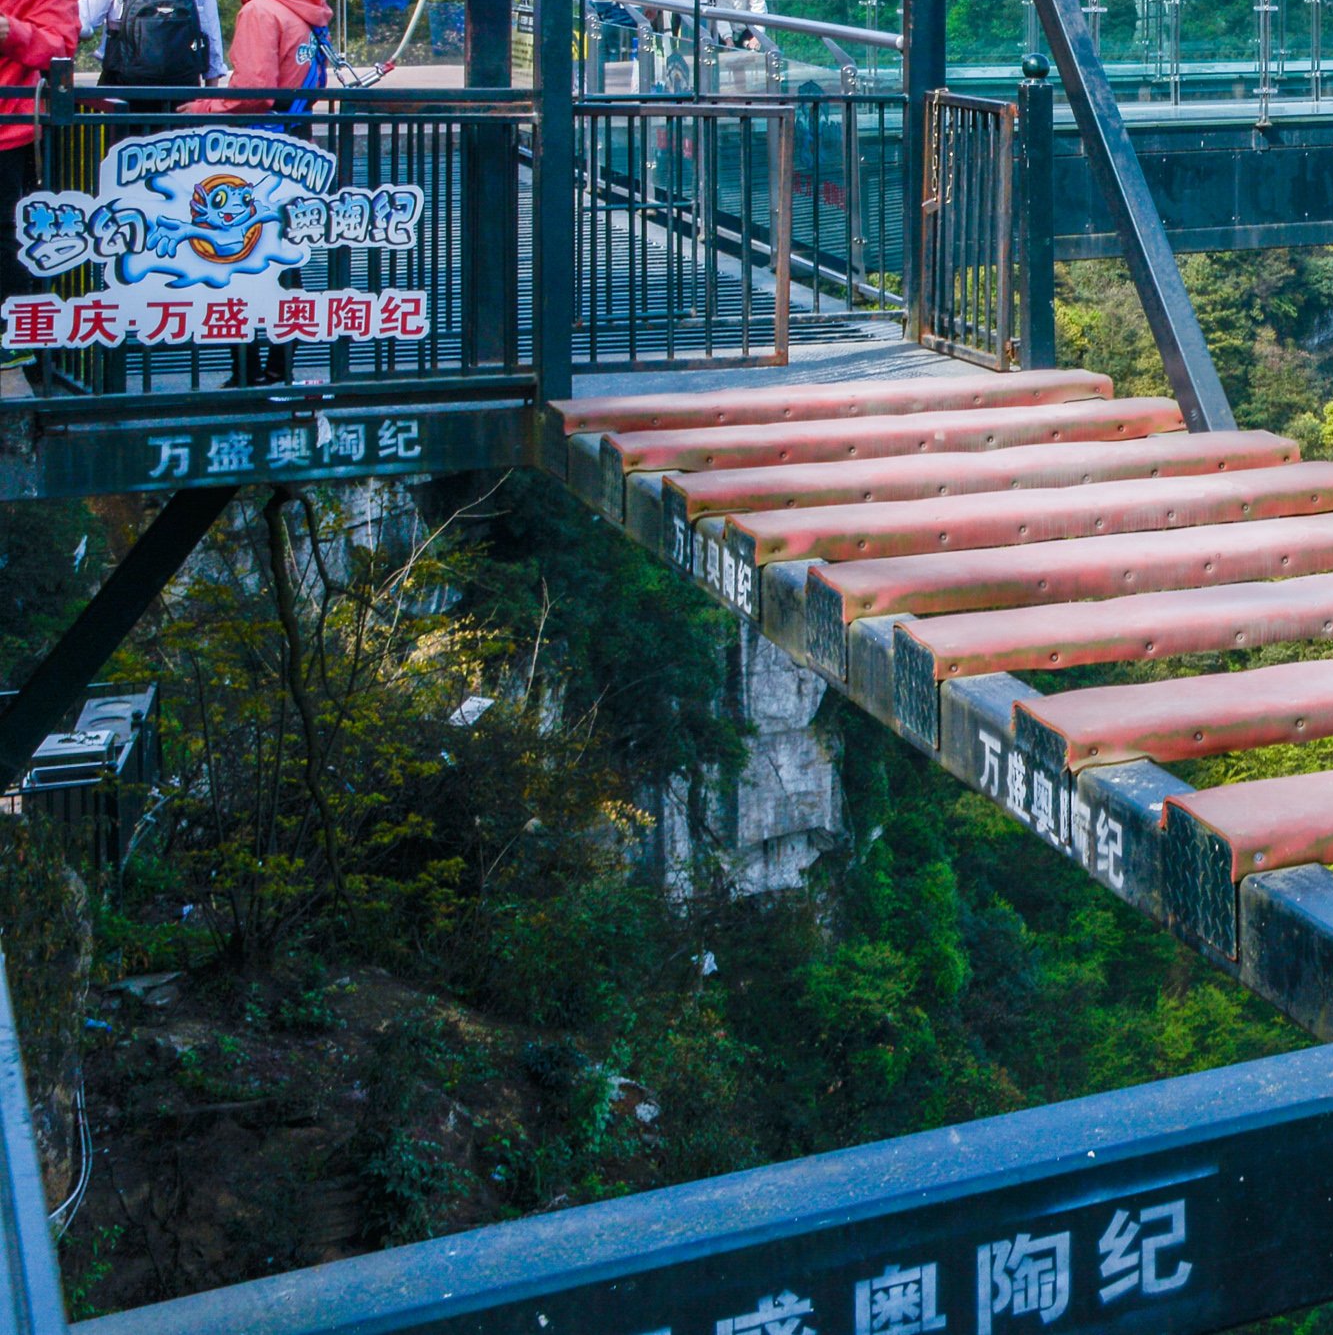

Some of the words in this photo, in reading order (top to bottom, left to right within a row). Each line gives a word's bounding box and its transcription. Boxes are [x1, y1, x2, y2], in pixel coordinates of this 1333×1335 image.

[118, 134, 200, 186] DREAM
[204, 129, 335, 194] ORDOVICIAN
[22, 201, 147, 271] 梦幻
[283, 191, 418, 246] 奥陶纪
[147, 419, 422, 479] 万盛奥陶纪
[638, 1198, 1193, 1335] 奥陶纪
